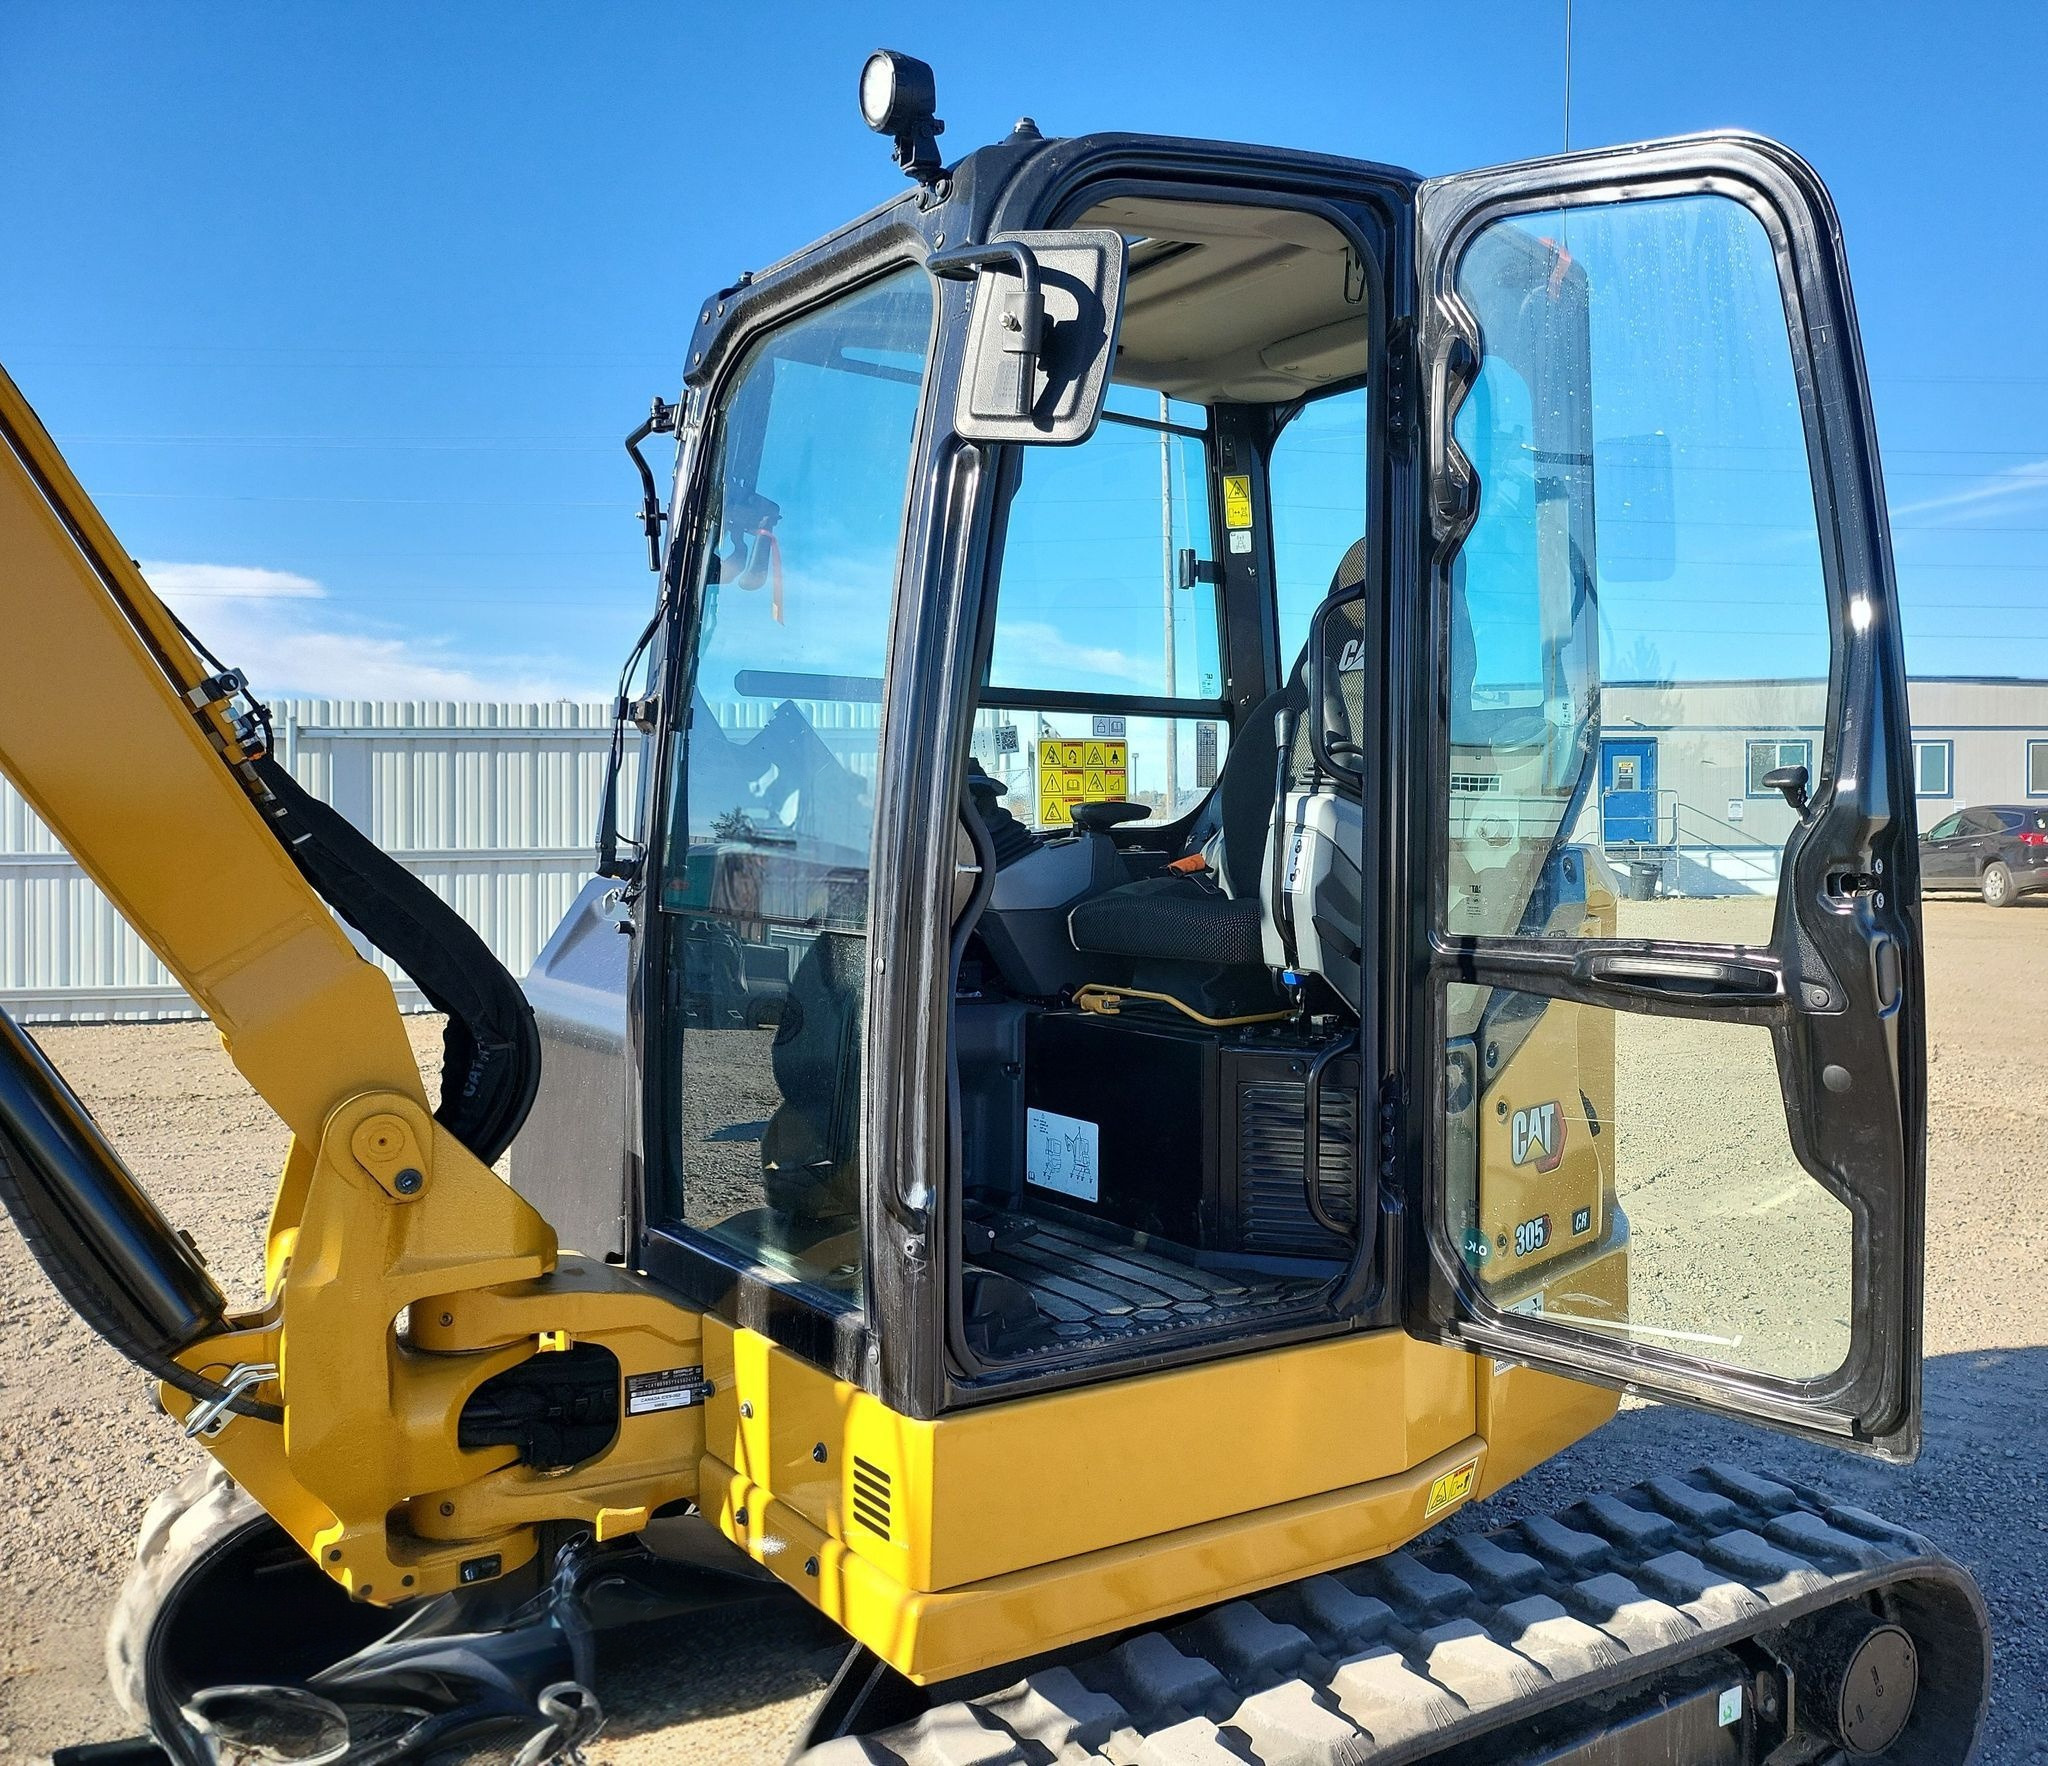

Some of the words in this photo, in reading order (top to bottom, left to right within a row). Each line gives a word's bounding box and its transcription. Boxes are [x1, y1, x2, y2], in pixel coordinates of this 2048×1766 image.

[1512, 1102, 1556, 1166] CAT
[1515, 1216, 1545, 1258] 305
[1575, 1212, 1588, 1230] CR
